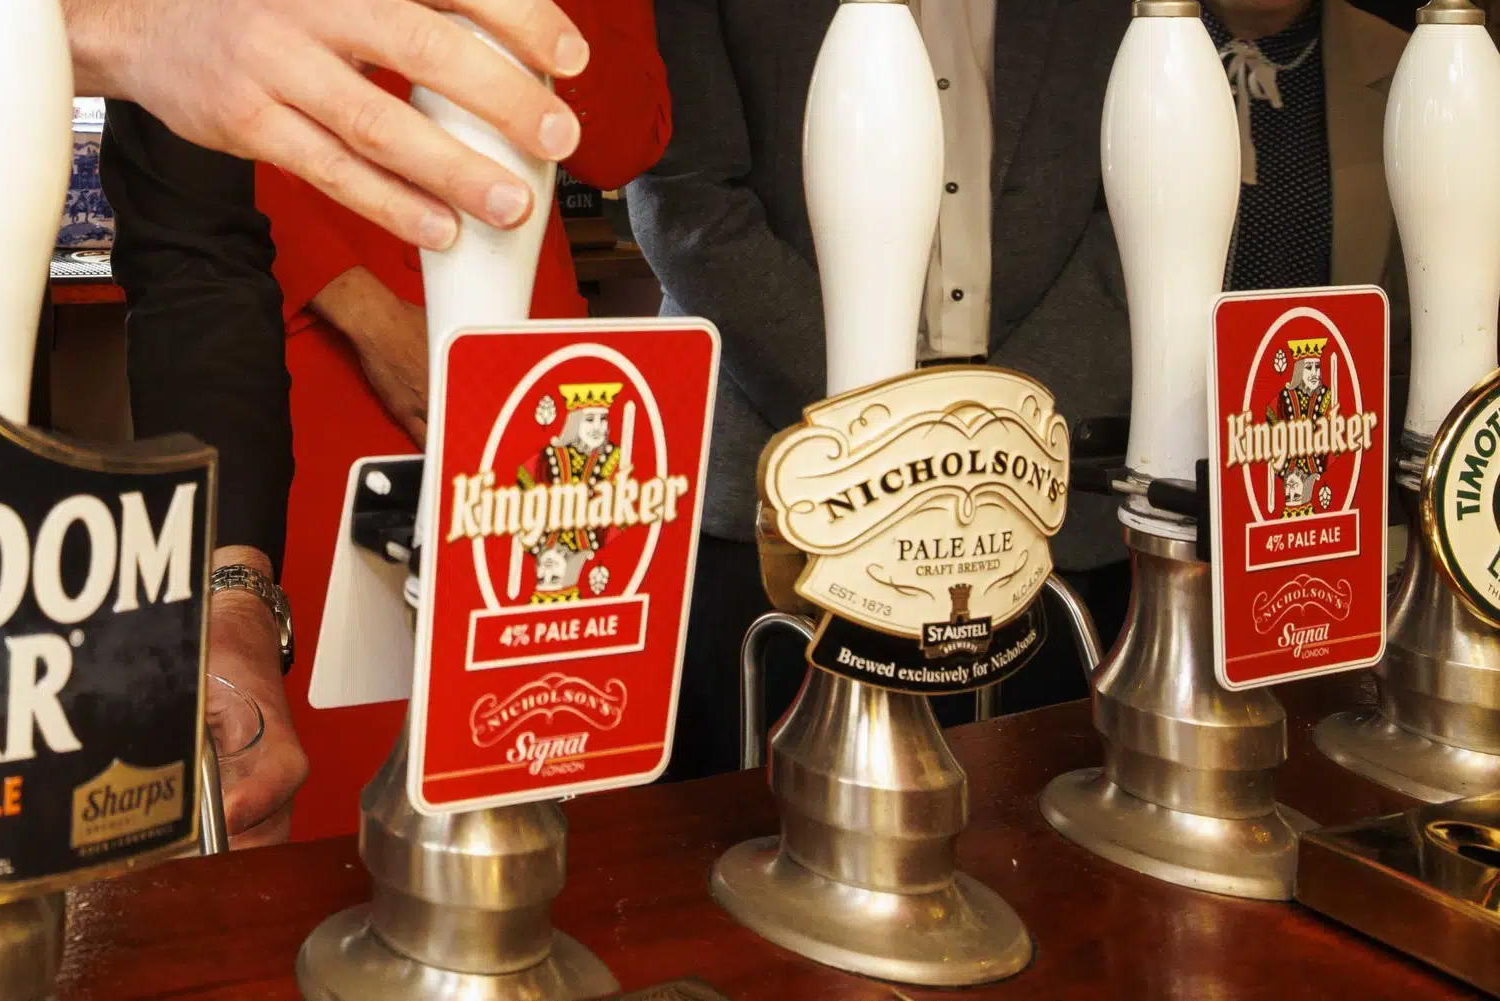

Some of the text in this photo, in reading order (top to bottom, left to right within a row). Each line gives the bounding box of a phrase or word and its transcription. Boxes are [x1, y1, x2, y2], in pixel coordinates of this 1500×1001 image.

[566, 193, 593, 209] GIN
[1227, 407, 1377, 469] Kingmaker
[1456, 408, 1500, 521] TIMOT
[819, 449, 1059, 524] NICHOLSON'S
[448, 467, 688, 546] Kingmaker
[897, 530, 1014, 562] PALE ALE
[1266, 526, 1341, 552] 4% PALE ALE
[915, 558, 1001, 577] CRAFT BREWED
[828, 582, 893, 617] EST. 1873
[1262, 588, 1342, 622] NICHOLSON'S
[499, 615, 619, 647] 4% PALE ALE
[1278, 622, 1330, 658] Signal
[836, 647, 895, 678] Brewed
[898, 666, 970, 684] exclusively
[973, 660, 988, 678] for
[1302, 647, 1330, 660] LONDON
[486, 688, 613, 732] NICHOLSON'S
[506, 731, 590, 777] Signal
[542, 761, 586, 778] LONDON
